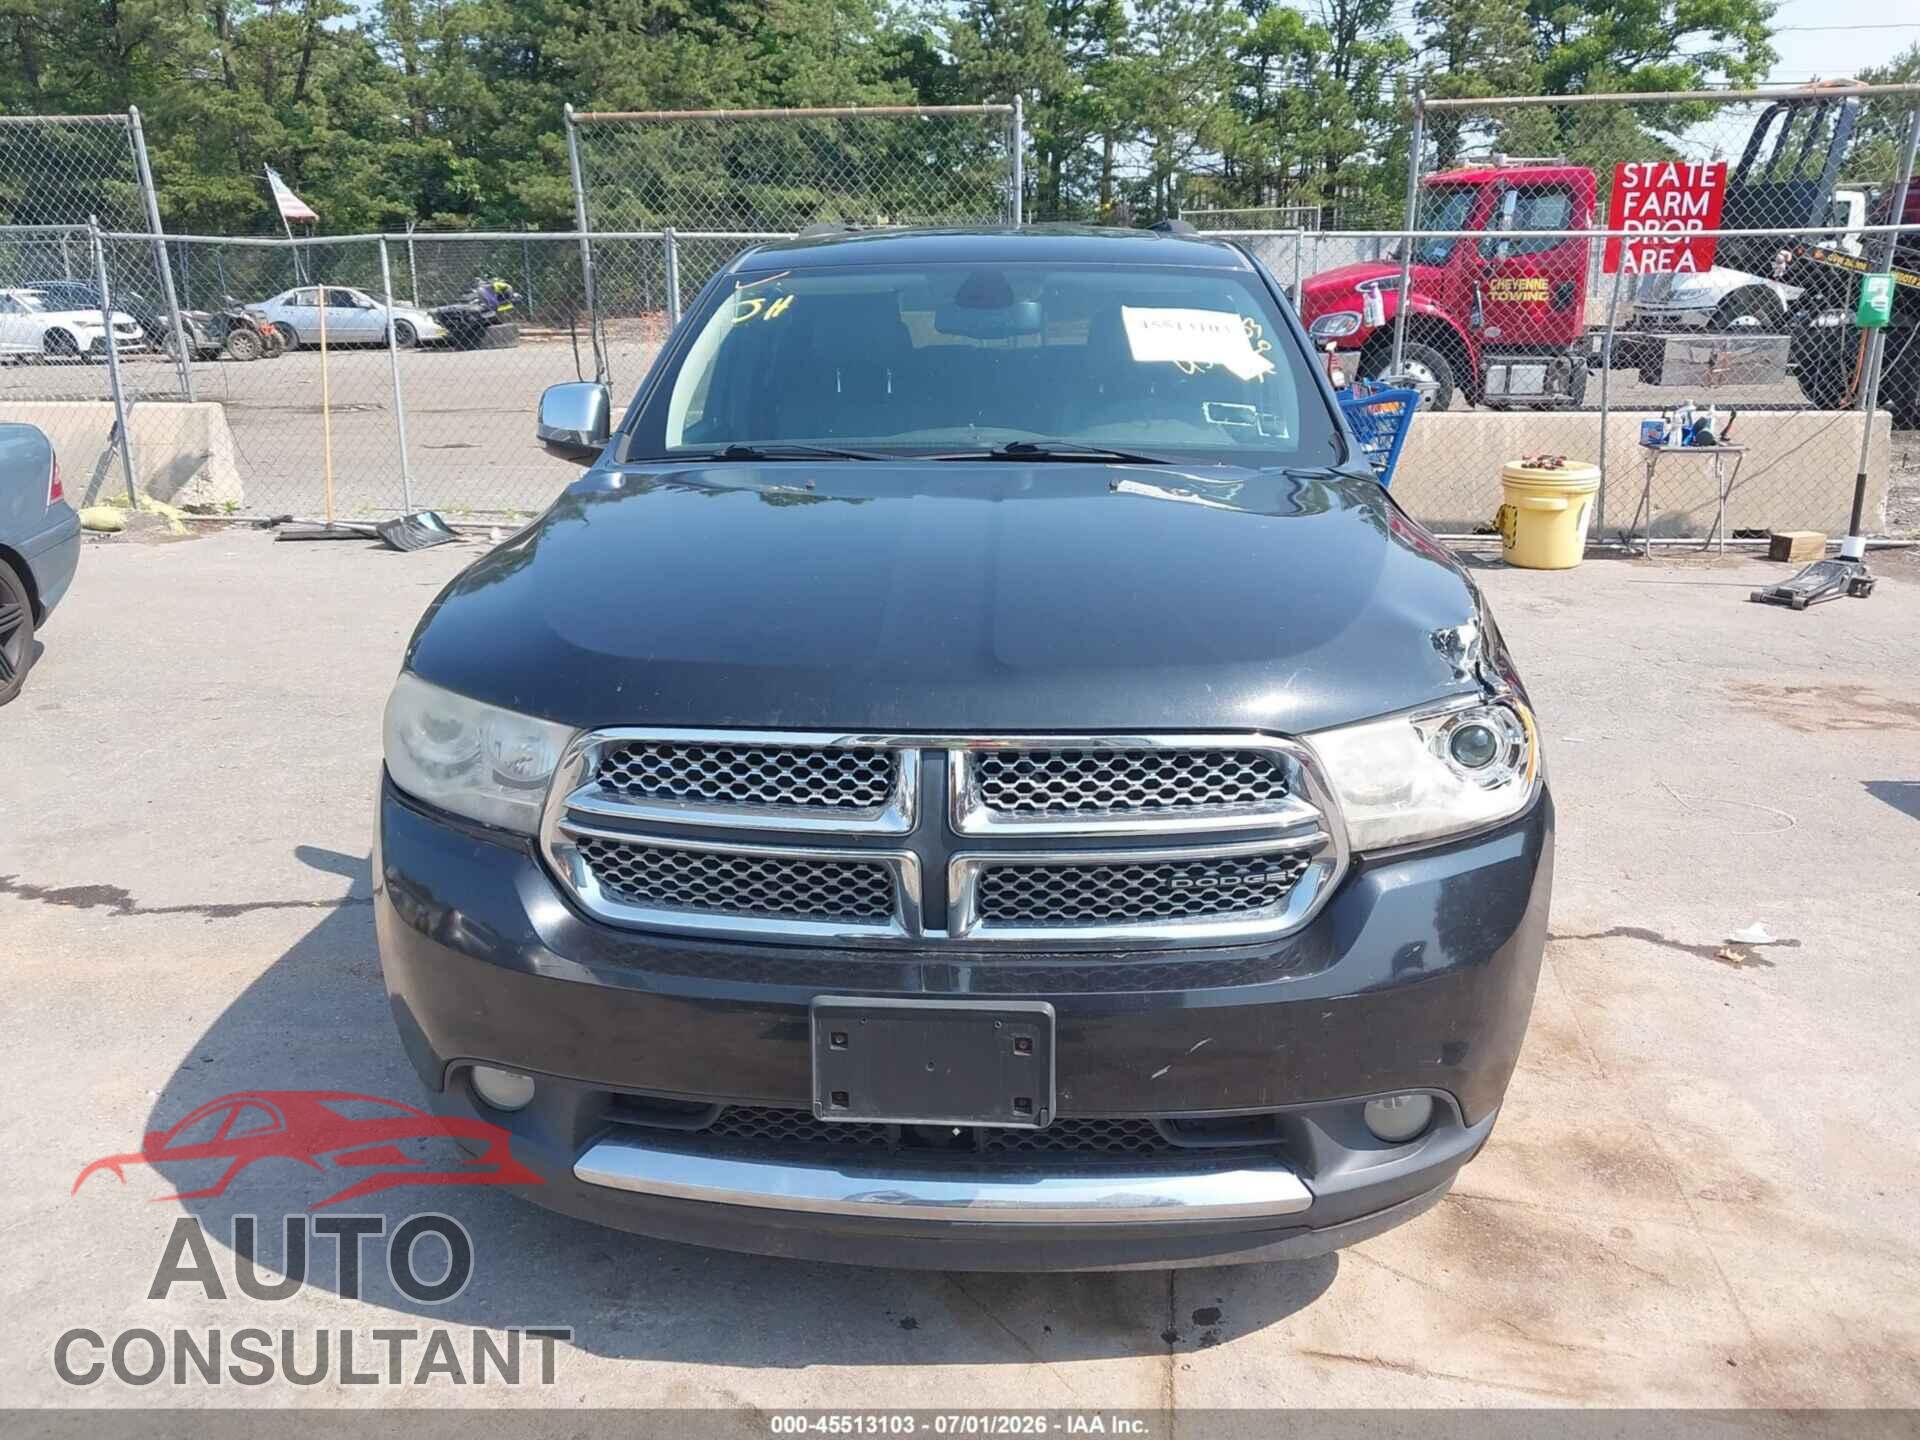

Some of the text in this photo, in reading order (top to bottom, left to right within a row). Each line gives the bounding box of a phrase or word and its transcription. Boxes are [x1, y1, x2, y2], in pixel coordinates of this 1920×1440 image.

[1622, 161, 1718, 188] STATE
[1623, 191, 1710, 217] FARM
[1623, 219, 1704, 245] DROP
[1621, 248, 1697, 274] AREA
[1488, 291, 1550, 302] TOWING
[1489, 278, 1550, 291] CHEYENNE
[1170, 871, 1288, 889] DODGE
